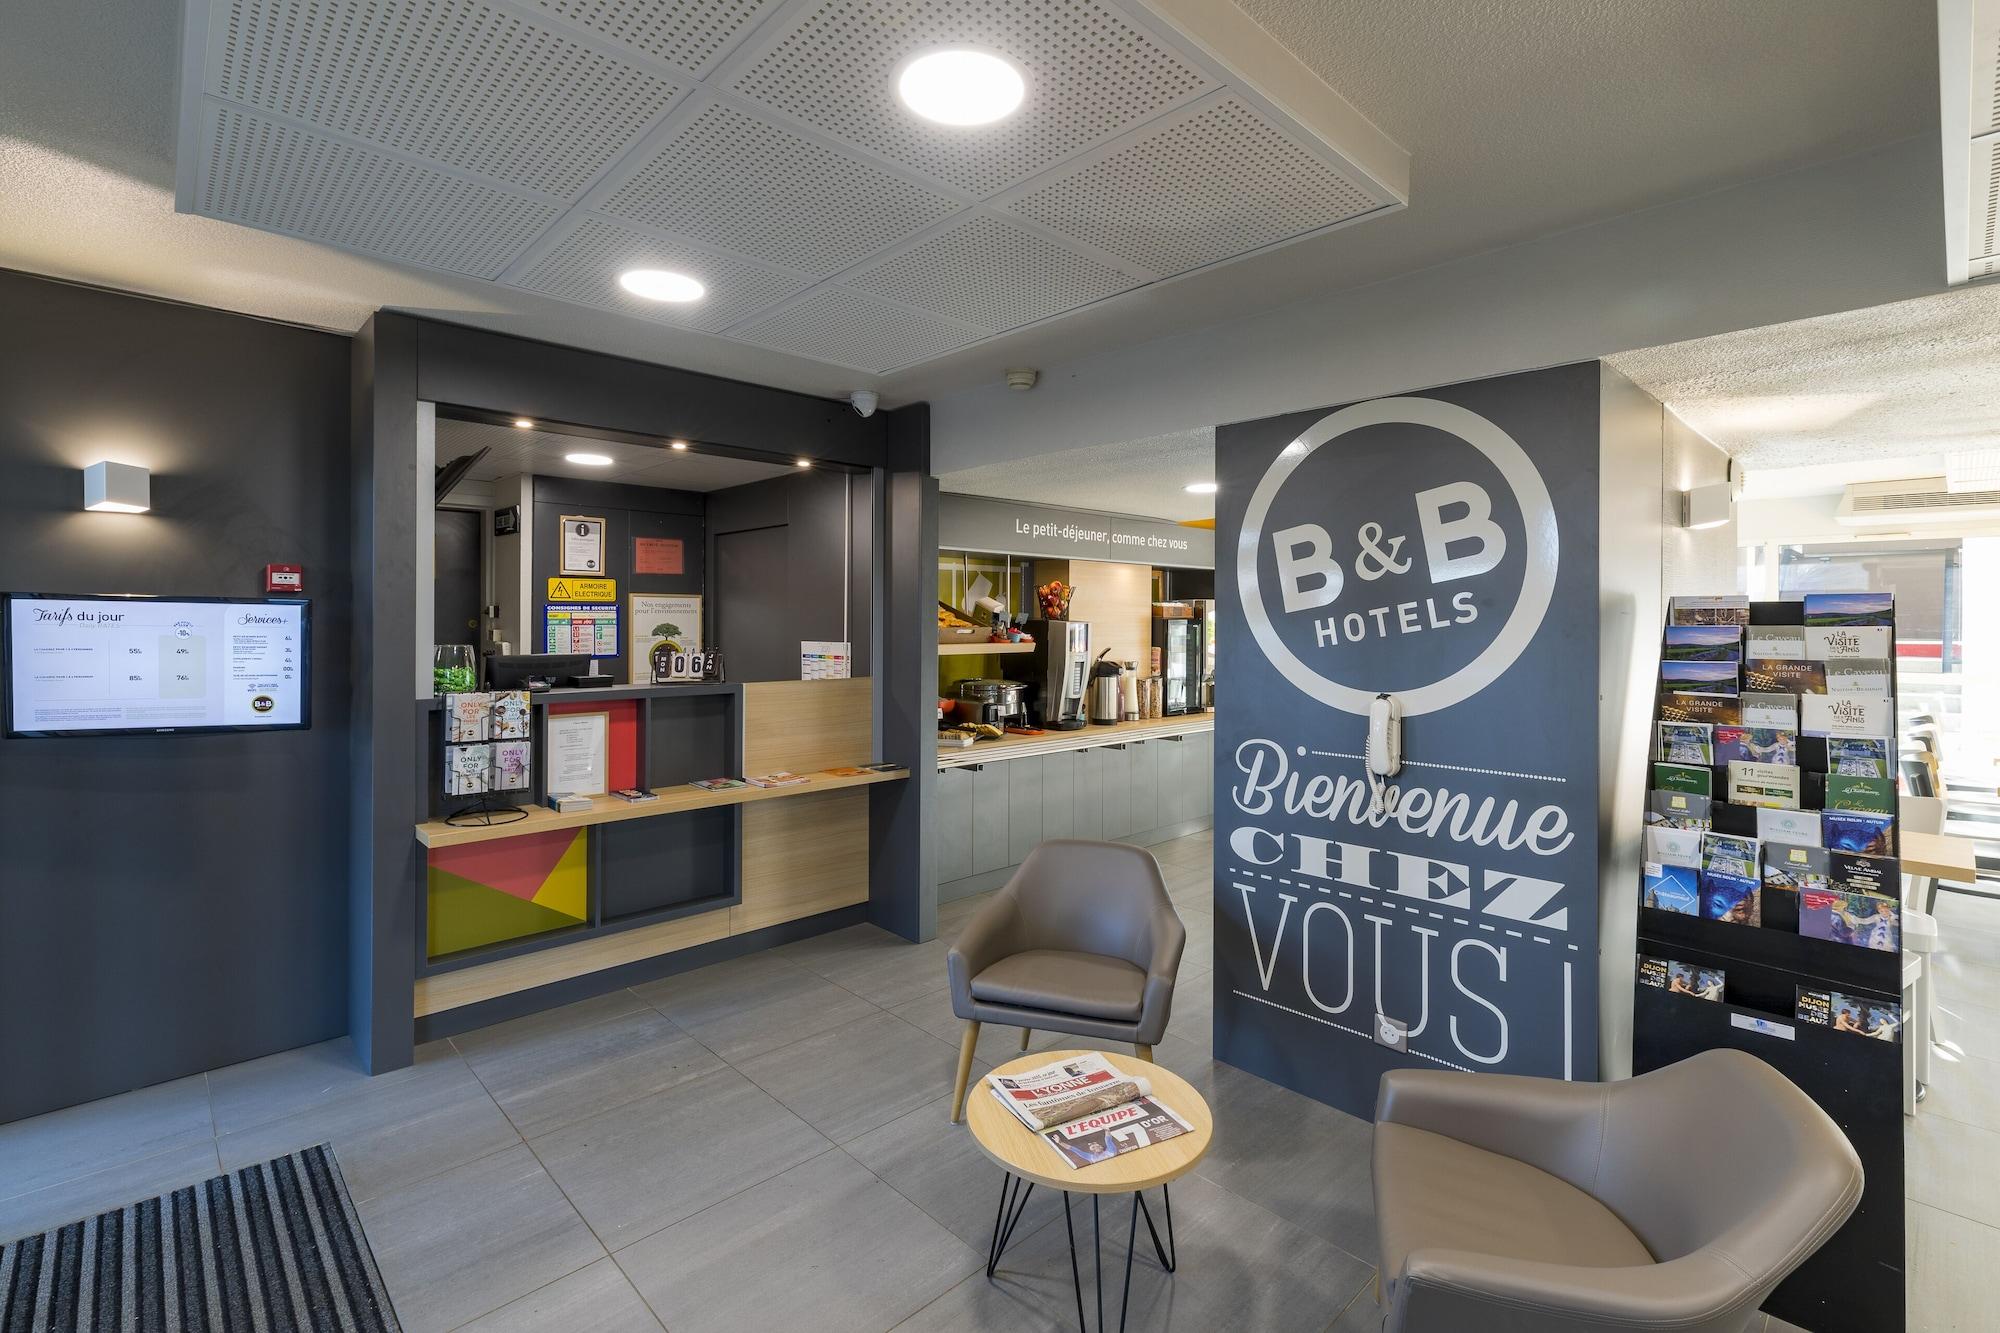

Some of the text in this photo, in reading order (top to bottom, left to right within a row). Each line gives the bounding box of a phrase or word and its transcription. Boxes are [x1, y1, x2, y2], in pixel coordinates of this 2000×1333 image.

[1015, 519, 1188, 550] Le petit-déjeuner, comme chez vous
[1272, 481, 1507, 614] B&B
[32, 607, 125, 626] Tarifs du jour
[1314, 591, 1479, 647] HOTELS
[659, 656, 667, 673] MON
[705, 653, 714, 670] JAN
[1775, 664, 1812, 672] GRANDE
[253, 700, 273, 708] B&B
[1688, 700, 1723, 708] GRANDE
[1741, 767, 1754, 776] 11
[1231, 738, 1575, 856] Bienvenue
[1229, 826, 1568, 931] CHEZ
[1232, 882, 1509, 1064] VOUS
[1643, 963, 1667, 973] DIJON
[1801, 996, 1829, 1007] DIJON
[1022, 1101, 1038, 1109] Les
[1076, 1090, 1085, 1098] de
[1140, 1115, 1169, 1128] D'OR
